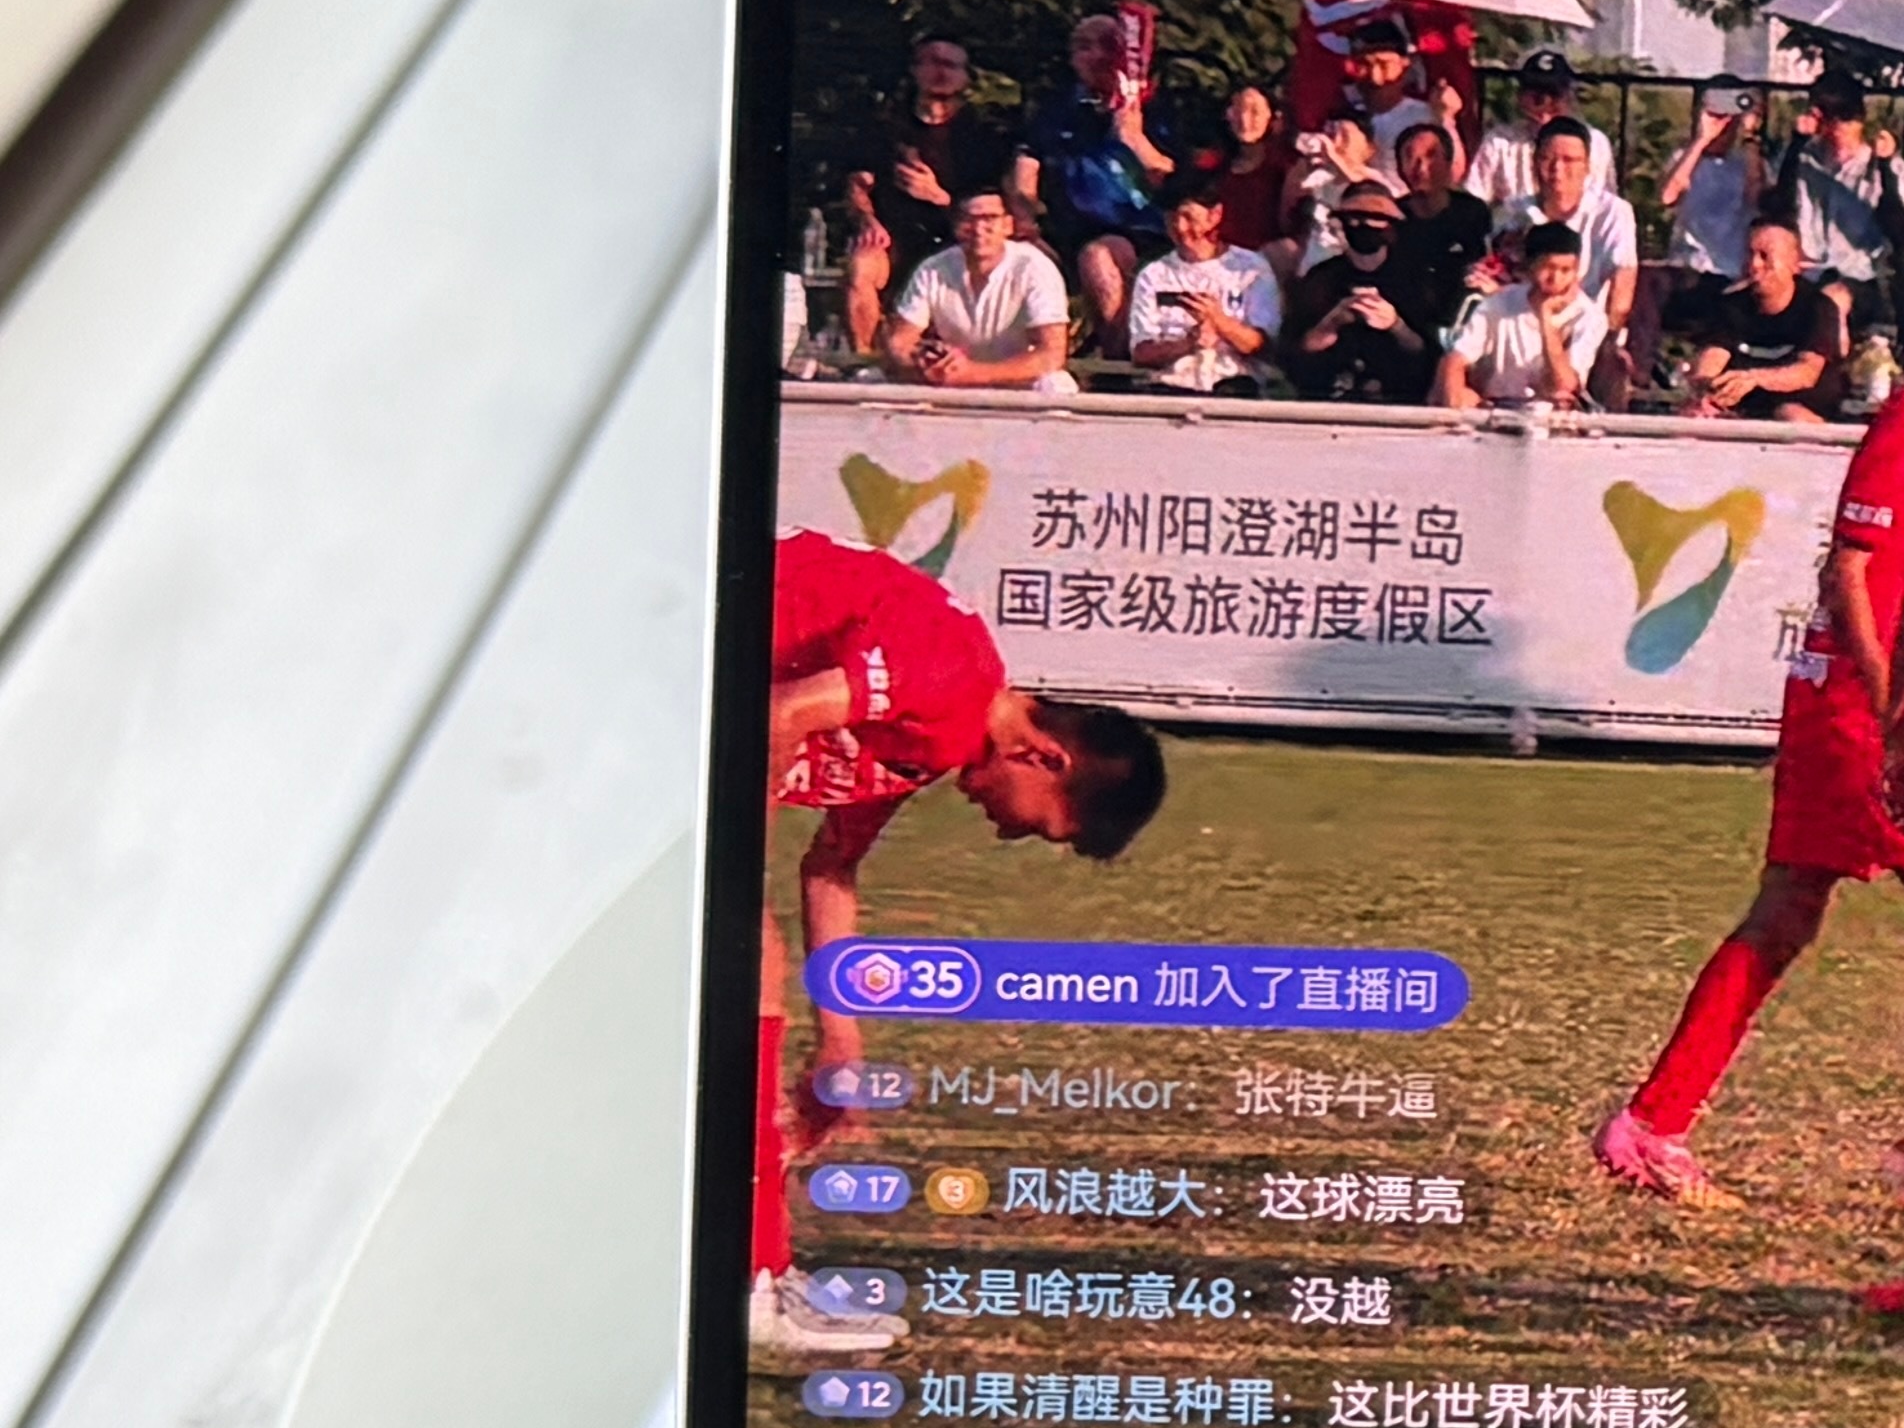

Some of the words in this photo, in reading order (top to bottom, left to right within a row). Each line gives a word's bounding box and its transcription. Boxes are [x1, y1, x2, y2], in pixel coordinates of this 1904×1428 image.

[1031, 487, 1465, 566] 苏州阳澄湖半岛
[997, 569, 1494, 647] 国家级旅游度假区
[910, 960, 963, 999] 35
[996, 970, 1139, 1005] camen
[1153, 962, 1440, 1016] 加入了直播间
[869, 1073, 900, 1099] 12
[1235, 1070, 1438, 1121] 张特牛逼
[868, 1176, 899, 1203] 17
[1259, 1172, 1465, 1225] 这球漂亮
[866, 1278, 885, 1305] 3
[1290, 1276, 1394, 1326] 没越
[857, 1380, 891, 1410] 12
